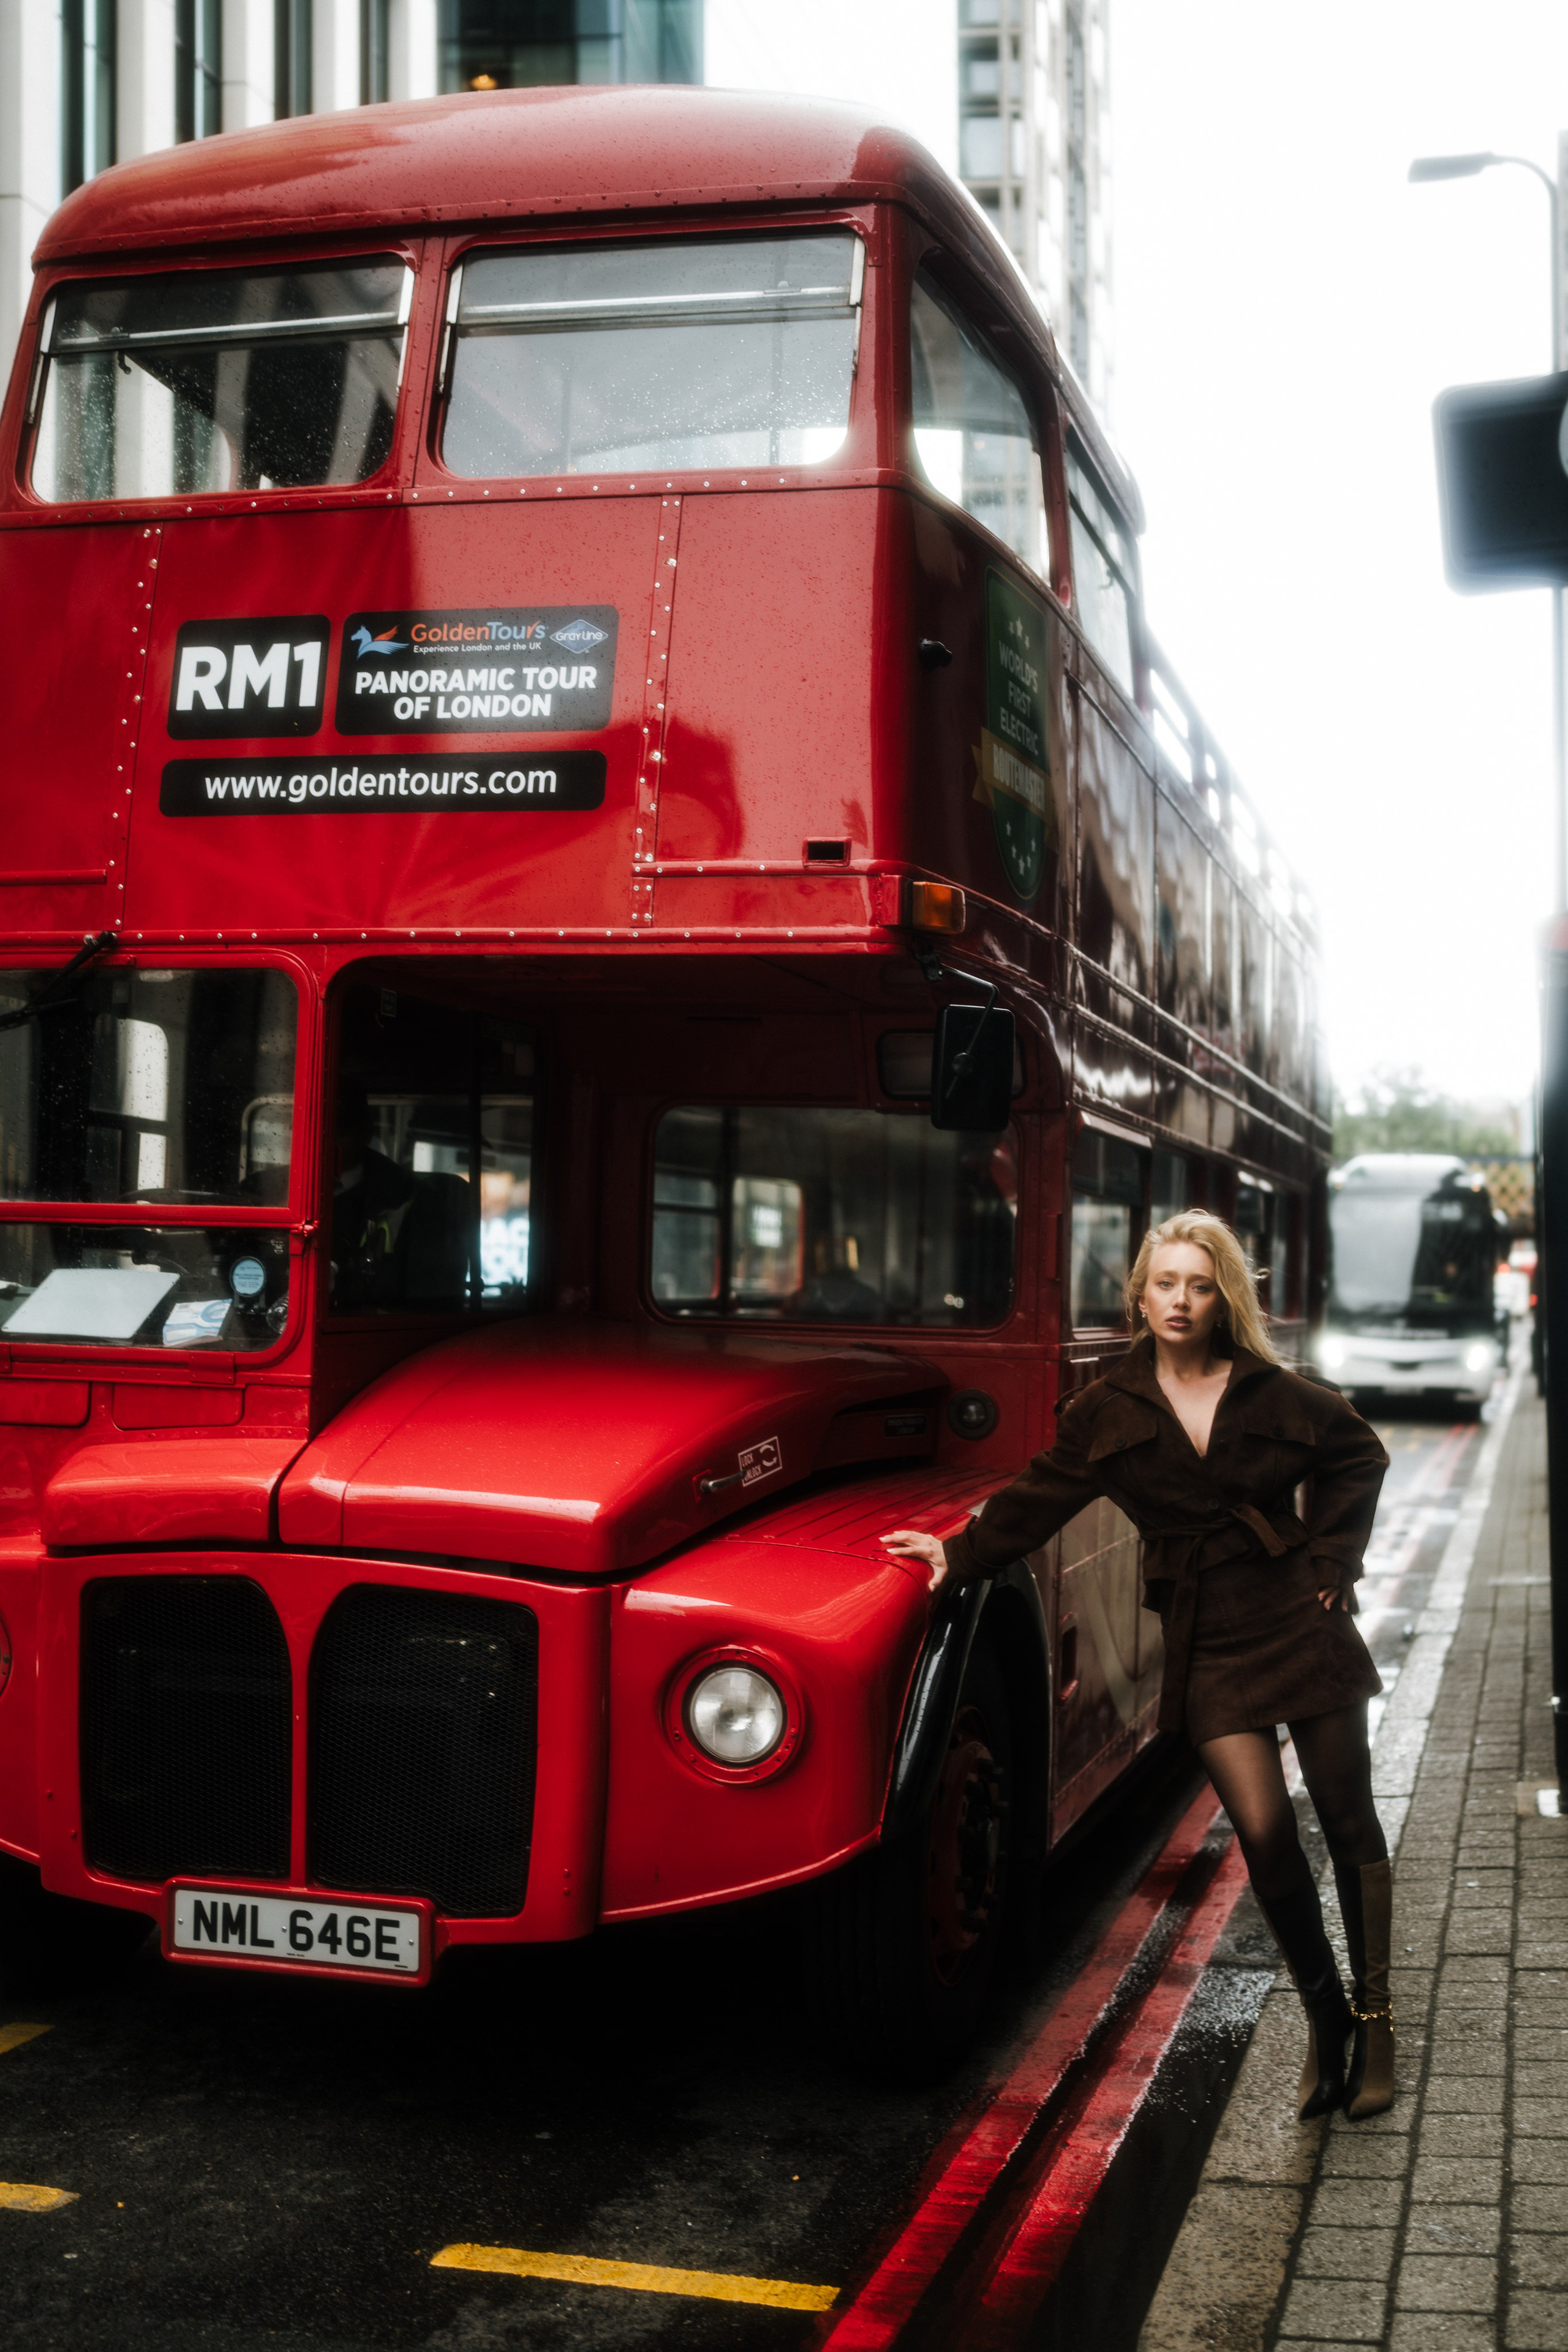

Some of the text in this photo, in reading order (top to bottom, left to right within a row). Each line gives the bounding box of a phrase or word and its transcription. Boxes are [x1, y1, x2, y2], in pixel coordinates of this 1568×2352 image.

[413, 645, 459, 655] Experience
[461, 643, 492, 652] London
[998, 641, 1038, 693] WORLD'S
[176, 641, 322, 711] RM1
[355, 666, 597, 695] PANORAMIC TOUR
[393, 693, 551, 720] OF LONDON
[1008, 680, 1031, 718] FIRST
[1000, 706, 1038, 756] ELECTRIC
[205, 766, 557, 804] www.goldentours.com
[193, 1899, 400, 1961] NML 646E
